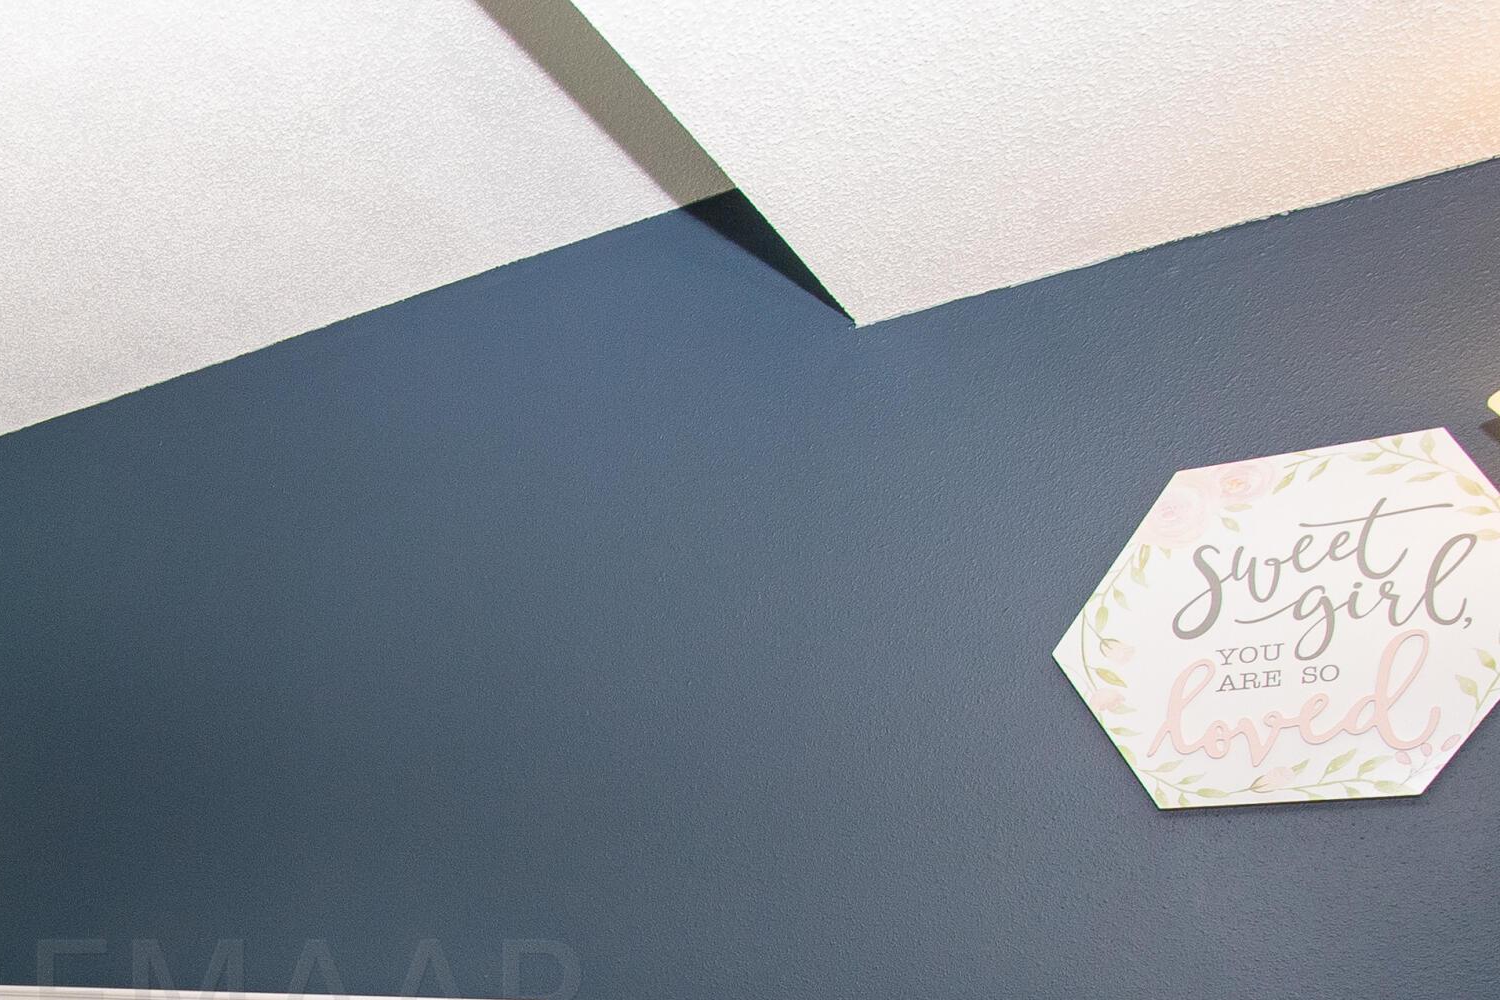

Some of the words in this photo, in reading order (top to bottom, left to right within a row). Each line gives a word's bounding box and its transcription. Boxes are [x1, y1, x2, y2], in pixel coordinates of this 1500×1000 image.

[1171, 496, 1454, 640] sweet
[1214, 669, 1282, 692] ARE
[1300, 664, 1341, 685] SO
[1215, 642, 1285, 666] YOU
[1146, 629, 1441, 768] loved
